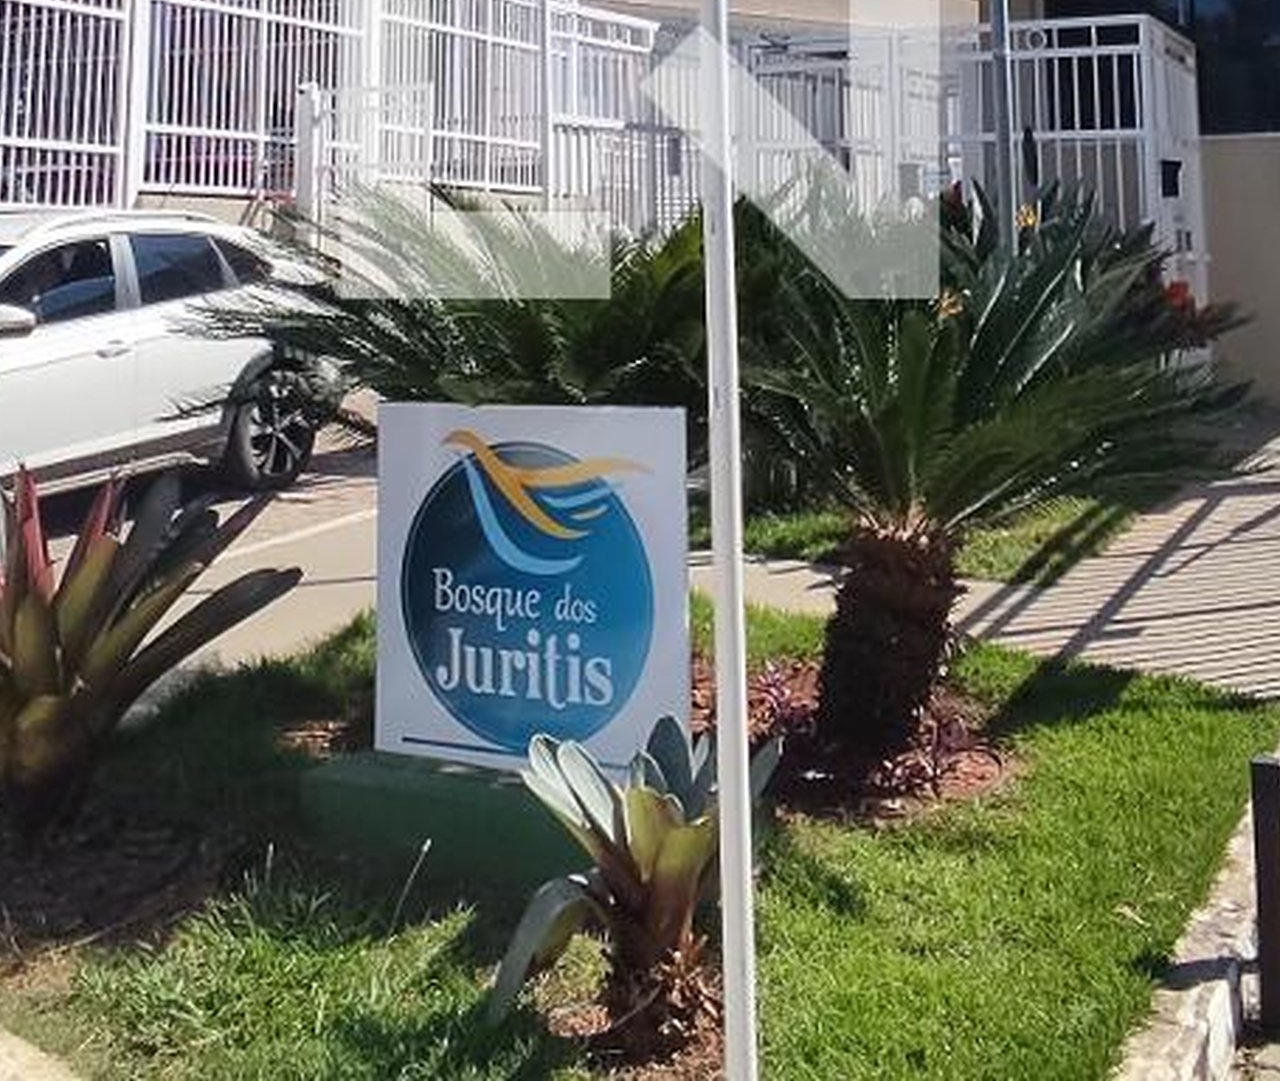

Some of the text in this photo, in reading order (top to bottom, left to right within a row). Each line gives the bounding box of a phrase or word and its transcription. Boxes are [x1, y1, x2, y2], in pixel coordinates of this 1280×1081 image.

[432, 568, 598, 632] Bosque dos
[436, 627, 614, 710] Juritis
